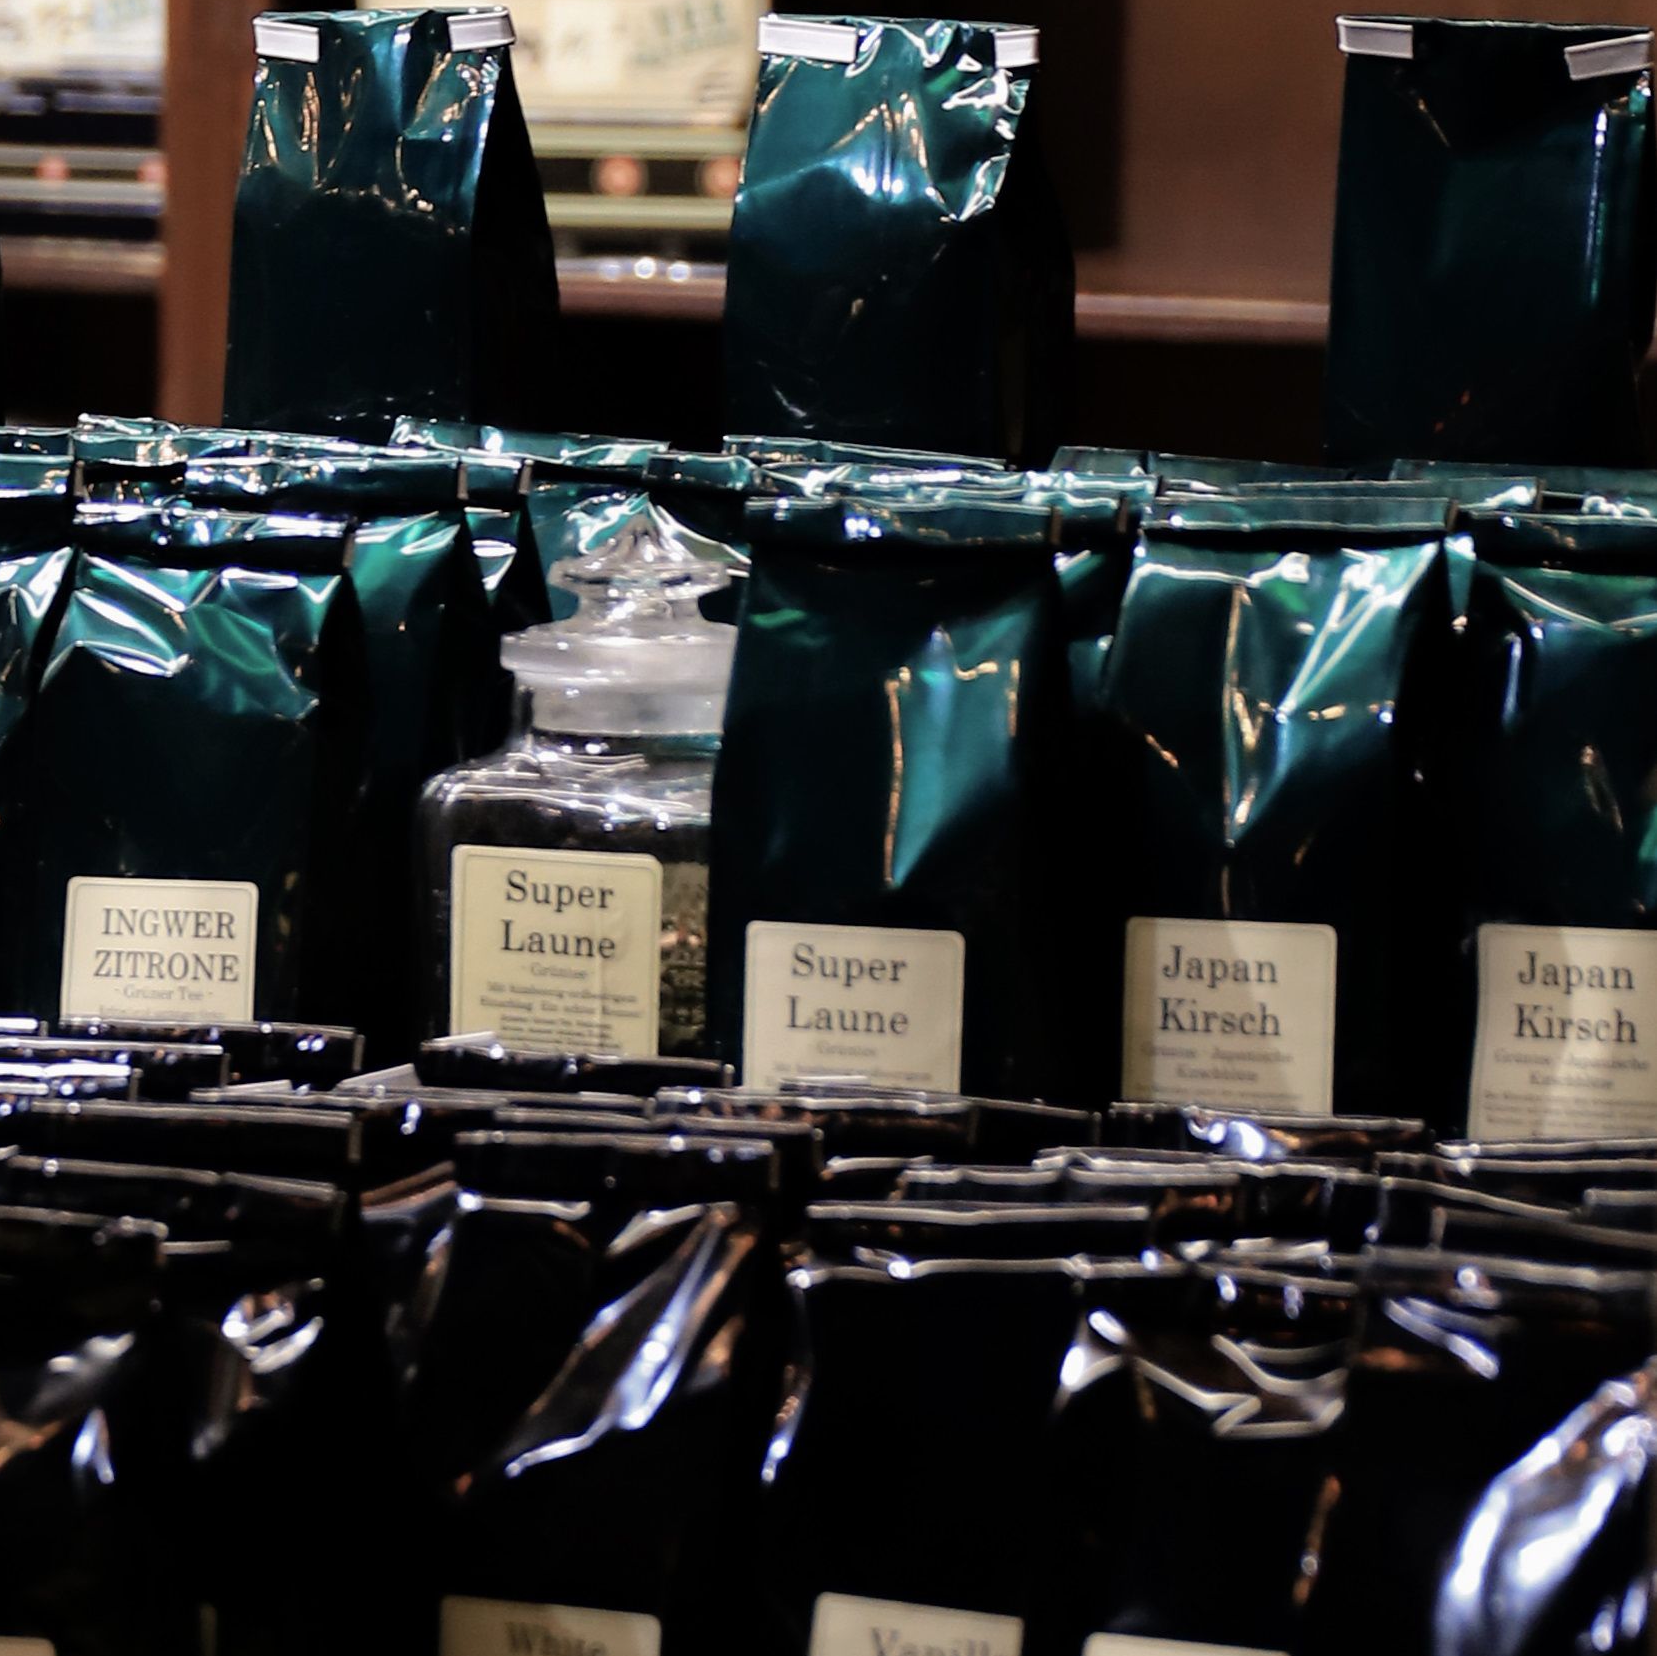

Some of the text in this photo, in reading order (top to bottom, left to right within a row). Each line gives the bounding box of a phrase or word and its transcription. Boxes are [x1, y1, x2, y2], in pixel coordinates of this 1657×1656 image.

[504, 868, 616, 914] Super
[100, 906, 237, 940] INGWER
[499, 918, 617, 960] Laune
[93, 948, 241, 983] ZITRONE
[791, 942, 908, 988] Super
[1161, 943, 1279, 989] Japan
[1516, 949, 1636, 996] Japan
[786, 994, 910, 1035] Laune
[1158, 996, 1281, 1037] Kirsch
[1513, 1001, 1639, 1044] Kirsch
